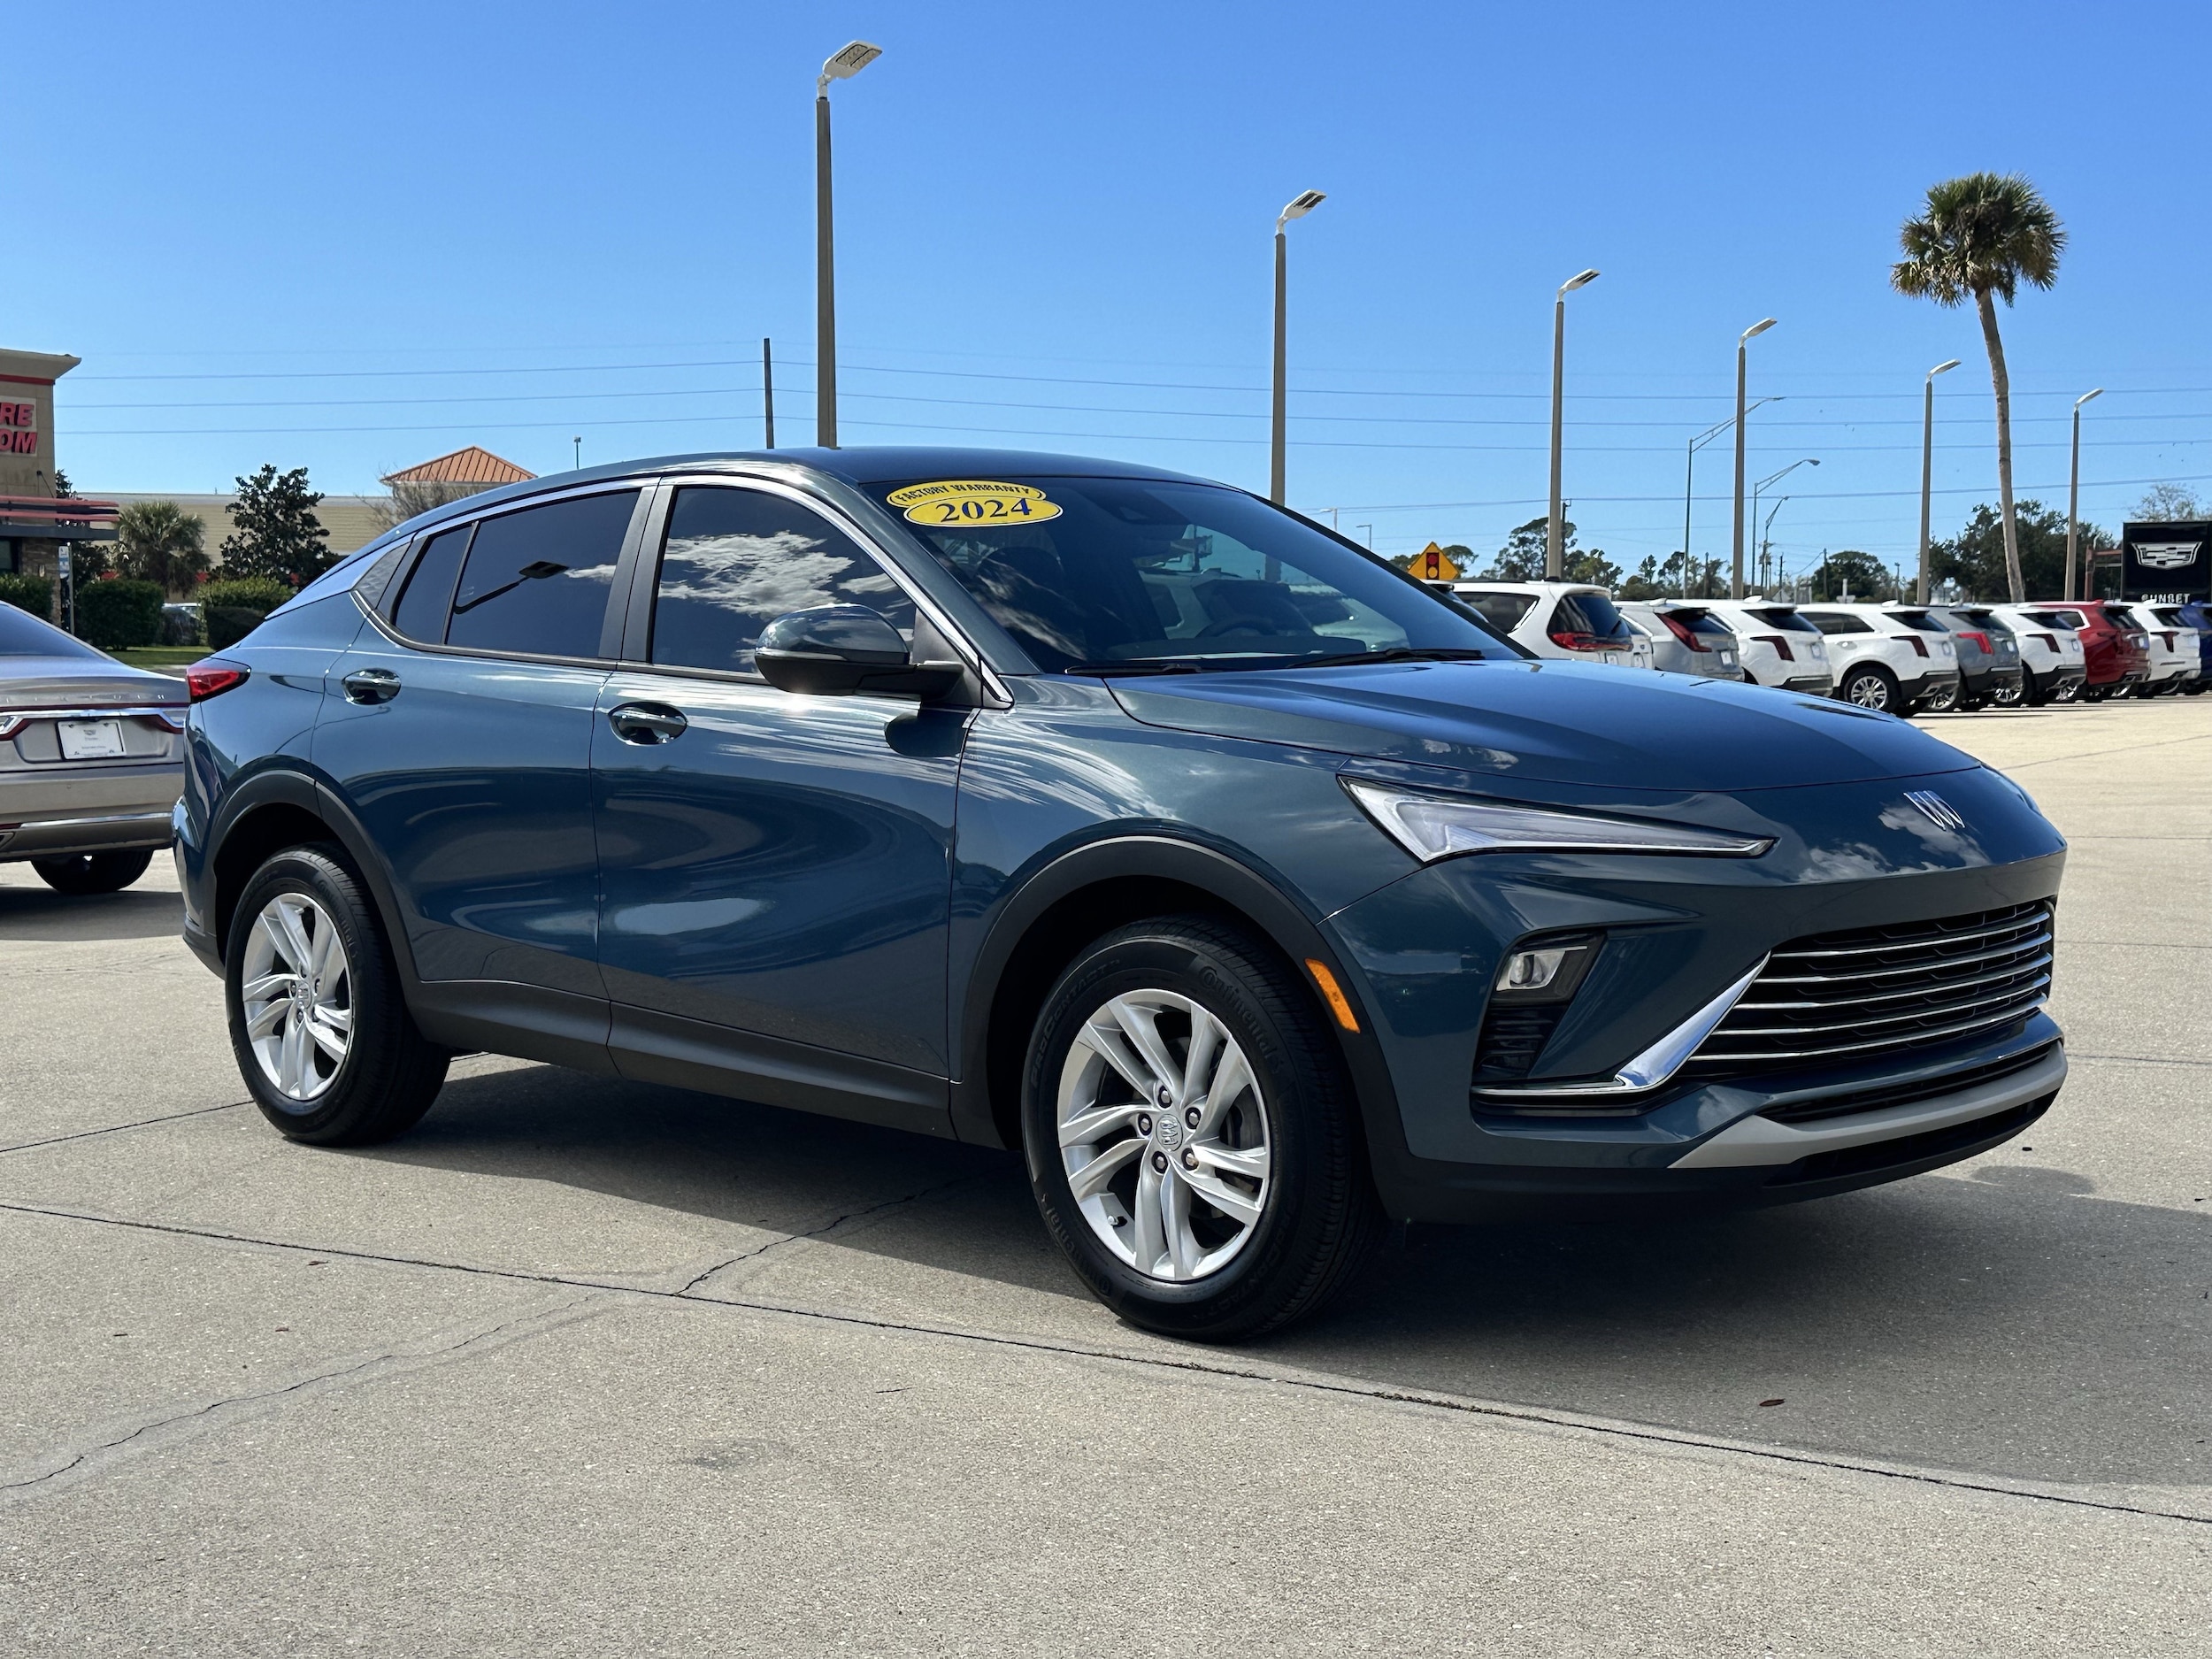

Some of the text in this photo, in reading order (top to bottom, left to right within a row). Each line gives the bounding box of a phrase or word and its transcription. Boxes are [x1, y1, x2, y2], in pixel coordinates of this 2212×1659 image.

[895, 483, 1030, 502] FACTORY WARRANTY
[936, 498, 1033, 523] 2024
[1199, 966, 1278, 1059] Continental
